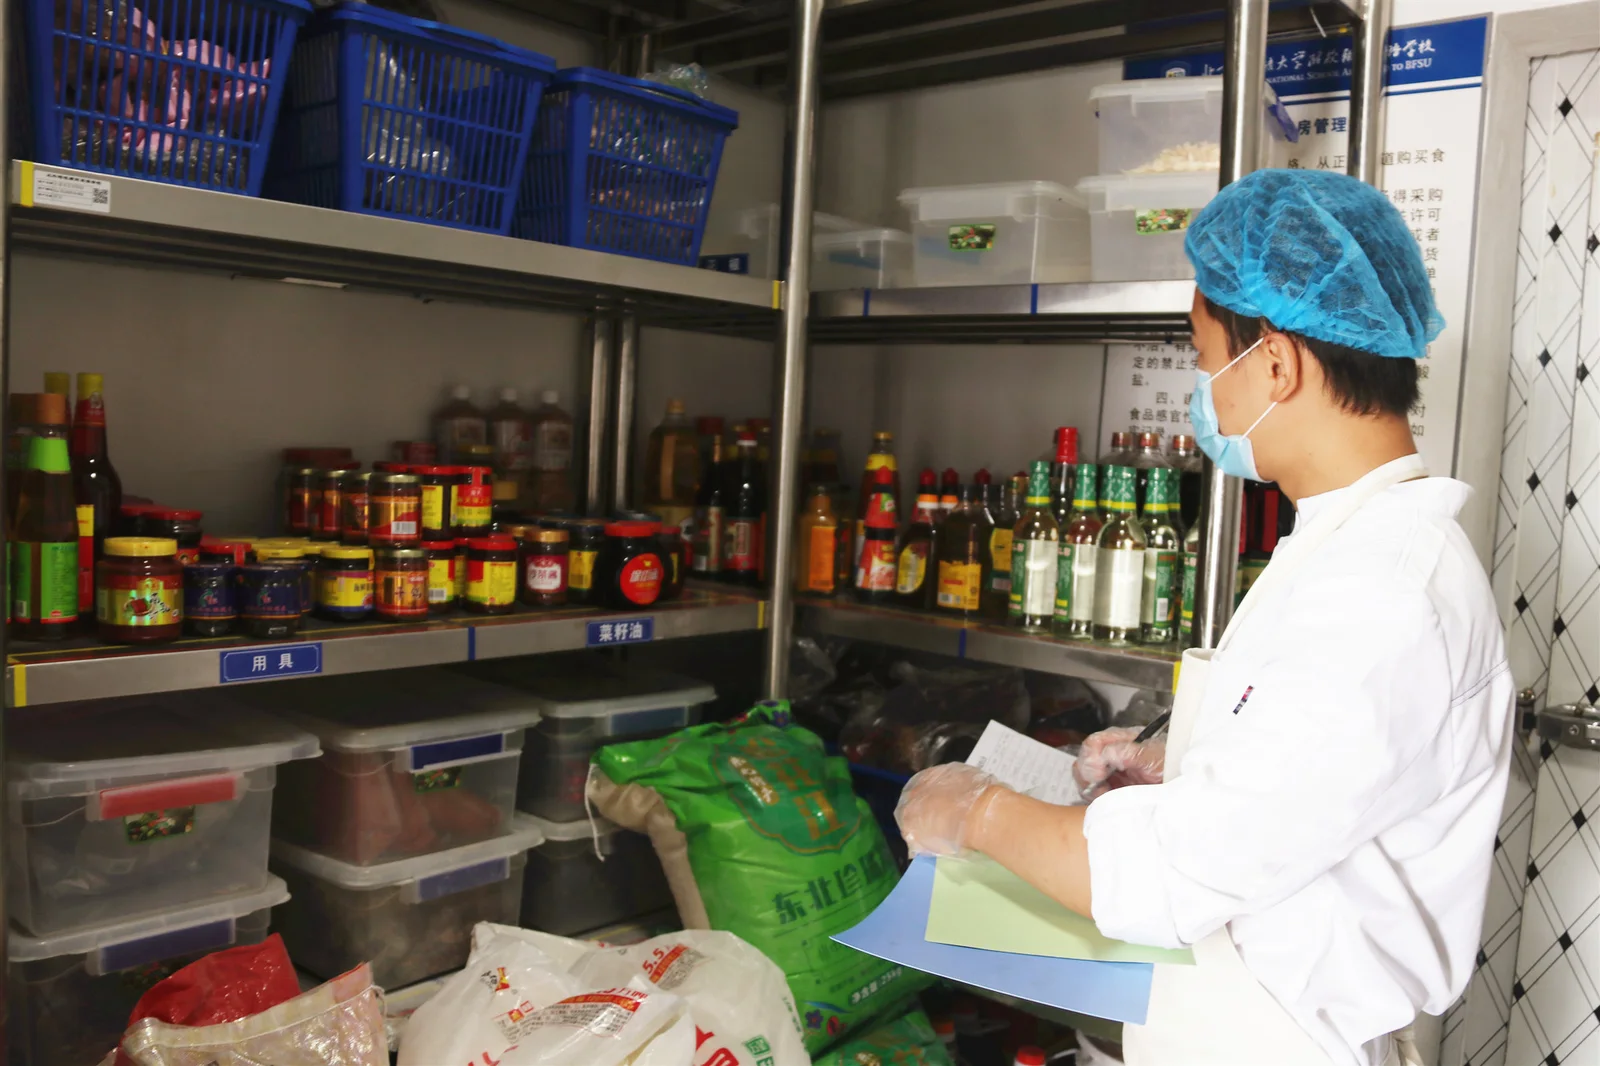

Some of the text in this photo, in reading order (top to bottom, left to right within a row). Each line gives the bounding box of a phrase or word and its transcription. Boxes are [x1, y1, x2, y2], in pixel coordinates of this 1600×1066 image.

[1405, 58, 1432, 70] BFSU
[599, 620, 643, 642] 菜籽油
[252, 653, 293, 672] 用具
